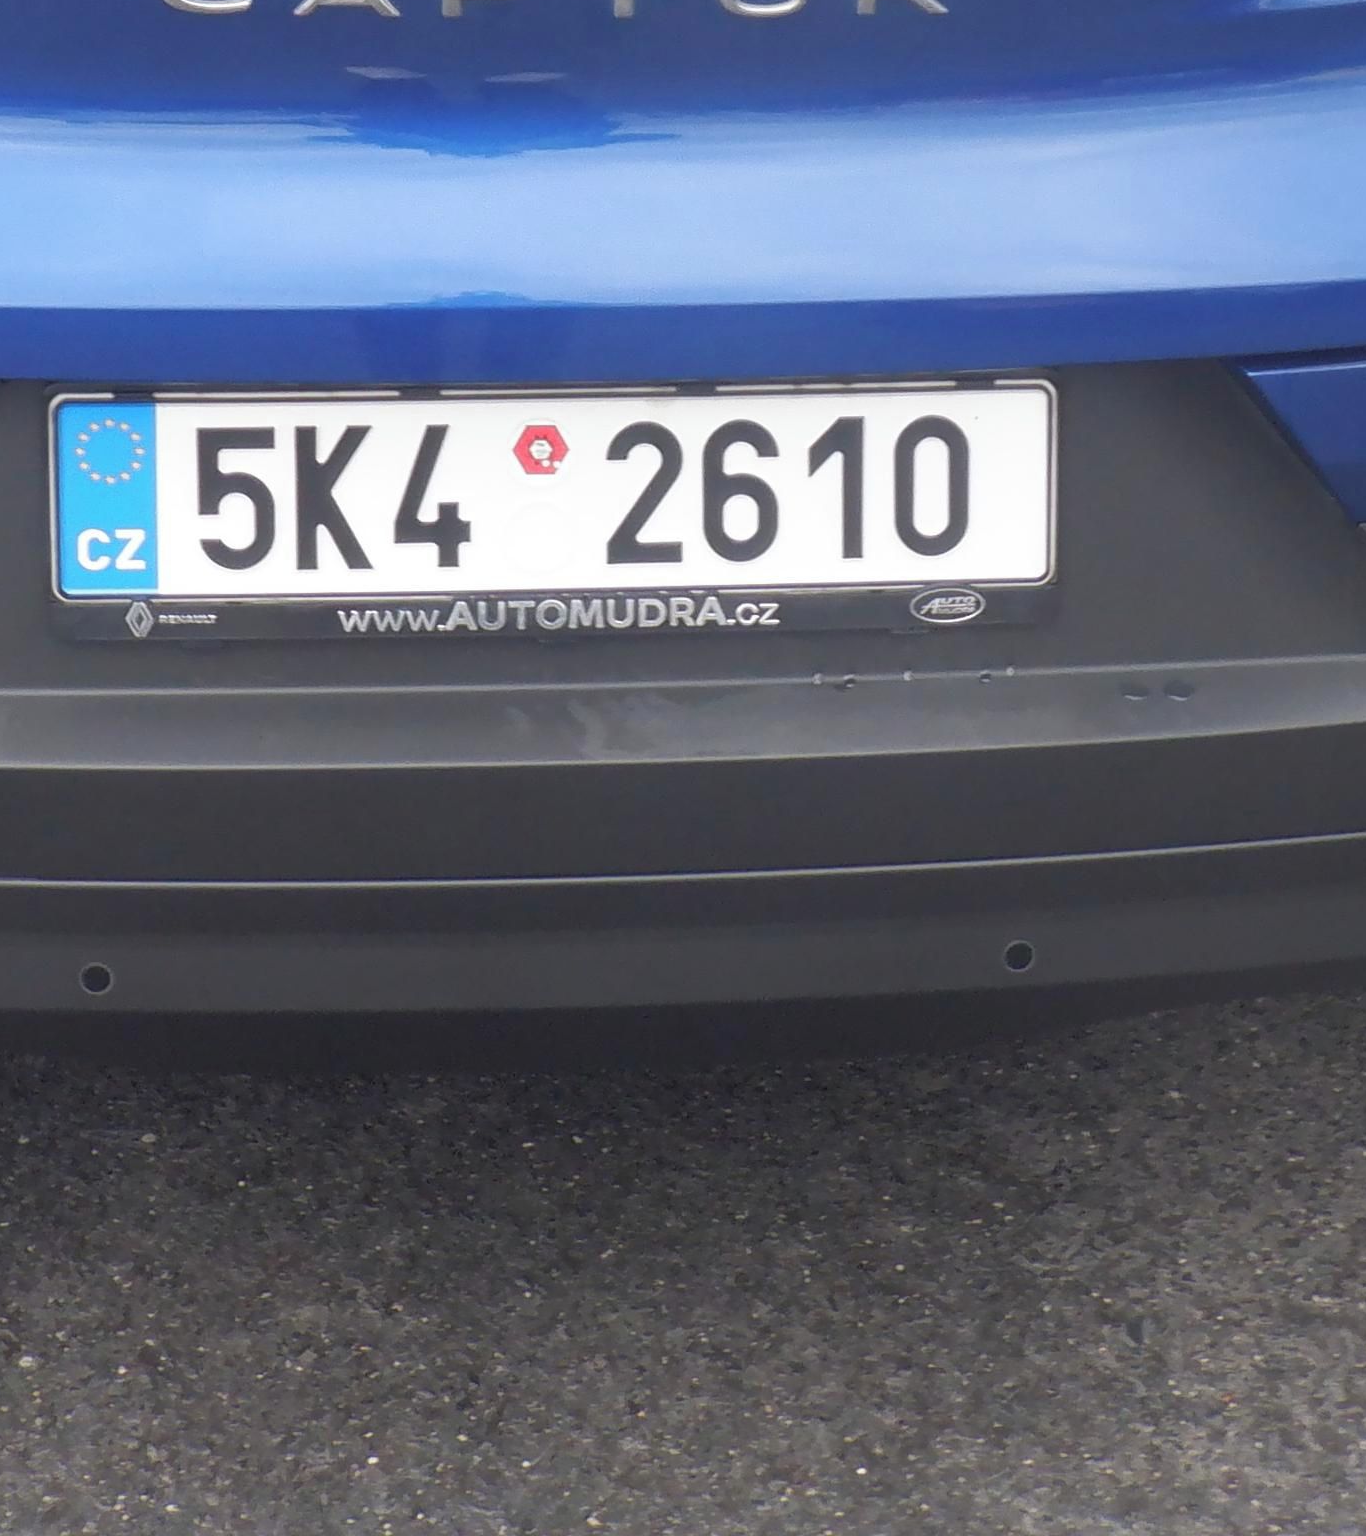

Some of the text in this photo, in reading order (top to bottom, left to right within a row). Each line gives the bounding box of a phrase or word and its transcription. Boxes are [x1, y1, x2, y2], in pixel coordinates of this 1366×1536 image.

[197, 415, 969, 570] 5K4 2610
[76, 528, 147, 571] CZ
